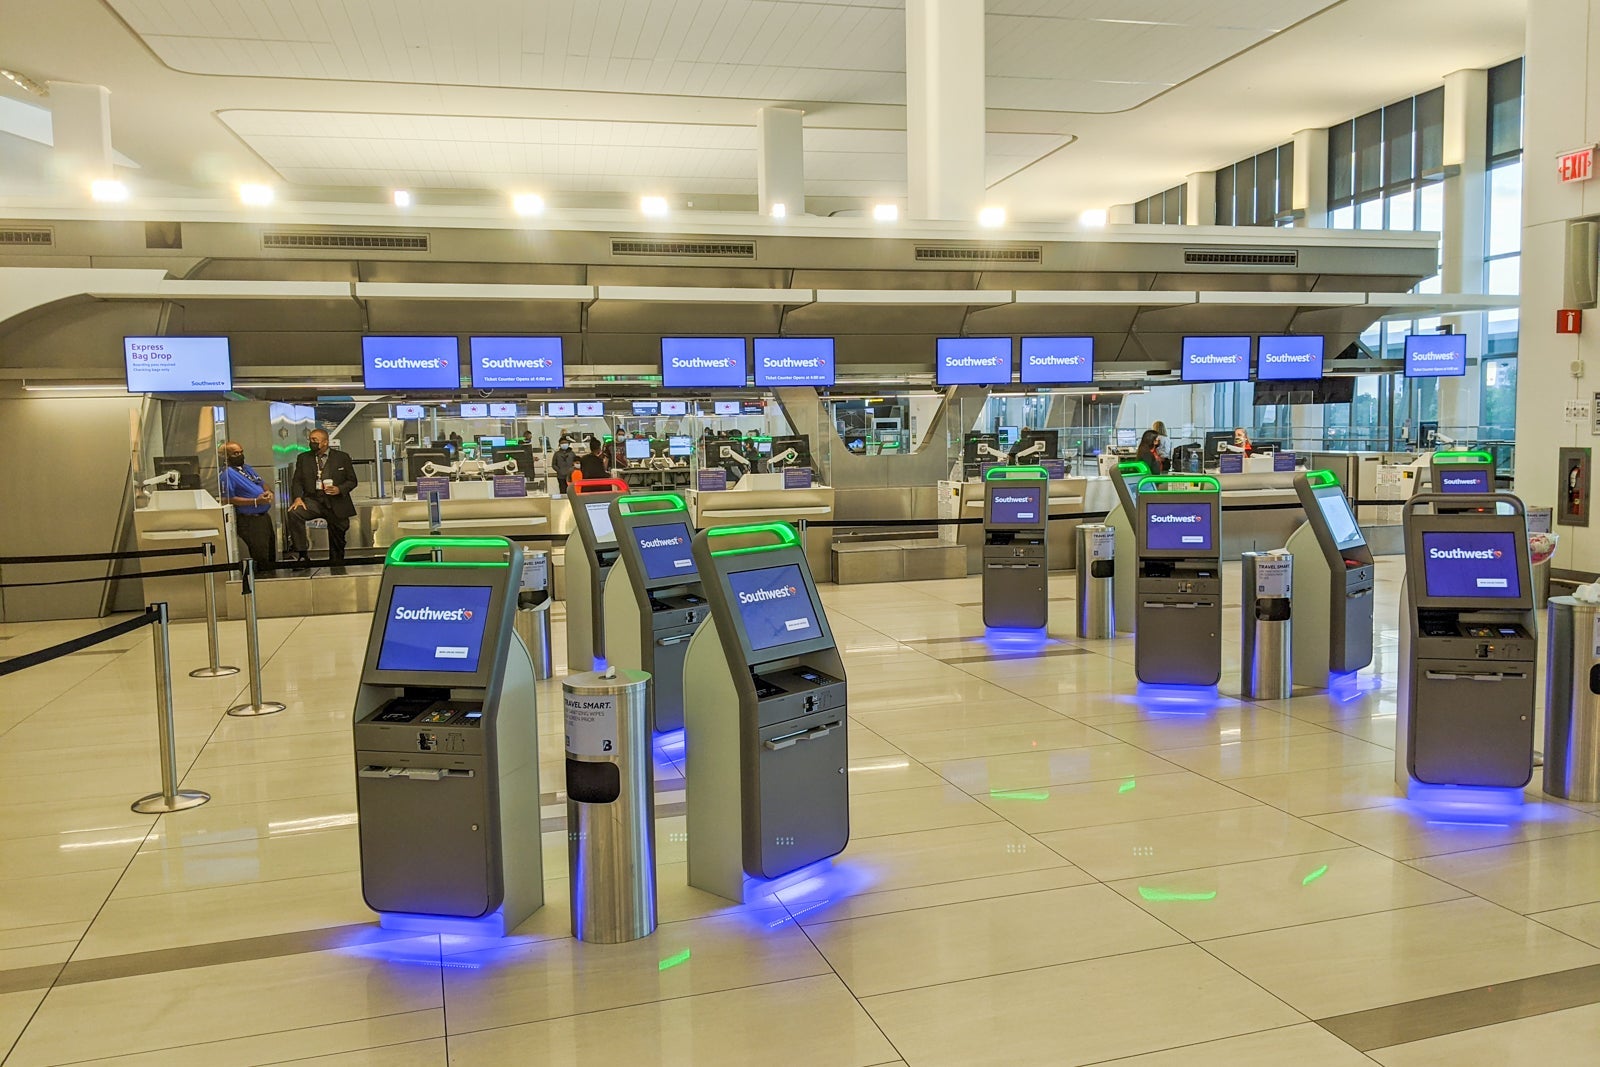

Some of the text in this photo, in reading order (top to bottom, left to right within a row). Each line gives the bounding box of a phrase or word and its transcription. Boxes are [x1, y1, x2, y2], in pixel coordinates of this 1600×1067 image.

[1562, 152, 1588, 181] EXIT
[131, 343, 164, 352] Express
[132, 352, 172, 361] Bag Drop
[945, 356, 997, 367] Southwest
[1029, 355, 1079, 365] Southwest
[1190, 354, 1237, 364] Southwest
[1265, 353, 1310, 363] Southwest
[1412, 351, 1454, 361] Southwest
[374, 357, 440, 369] Southwest
[482, 357, 545, 368] Southwest
[672, 357, 730, 368] Southwest
[763, 357, 818, 368] Southwest
[1150, 514, 1196, 523] Southwest
[640, 536, 679, 549] Southwest
[1429, 547, 1494, 559] Southwest
[738, 584, 791, 604] Southwest
[394, 606, 464, 621] Southwest
[583, 701, 611, 709] SMART.
